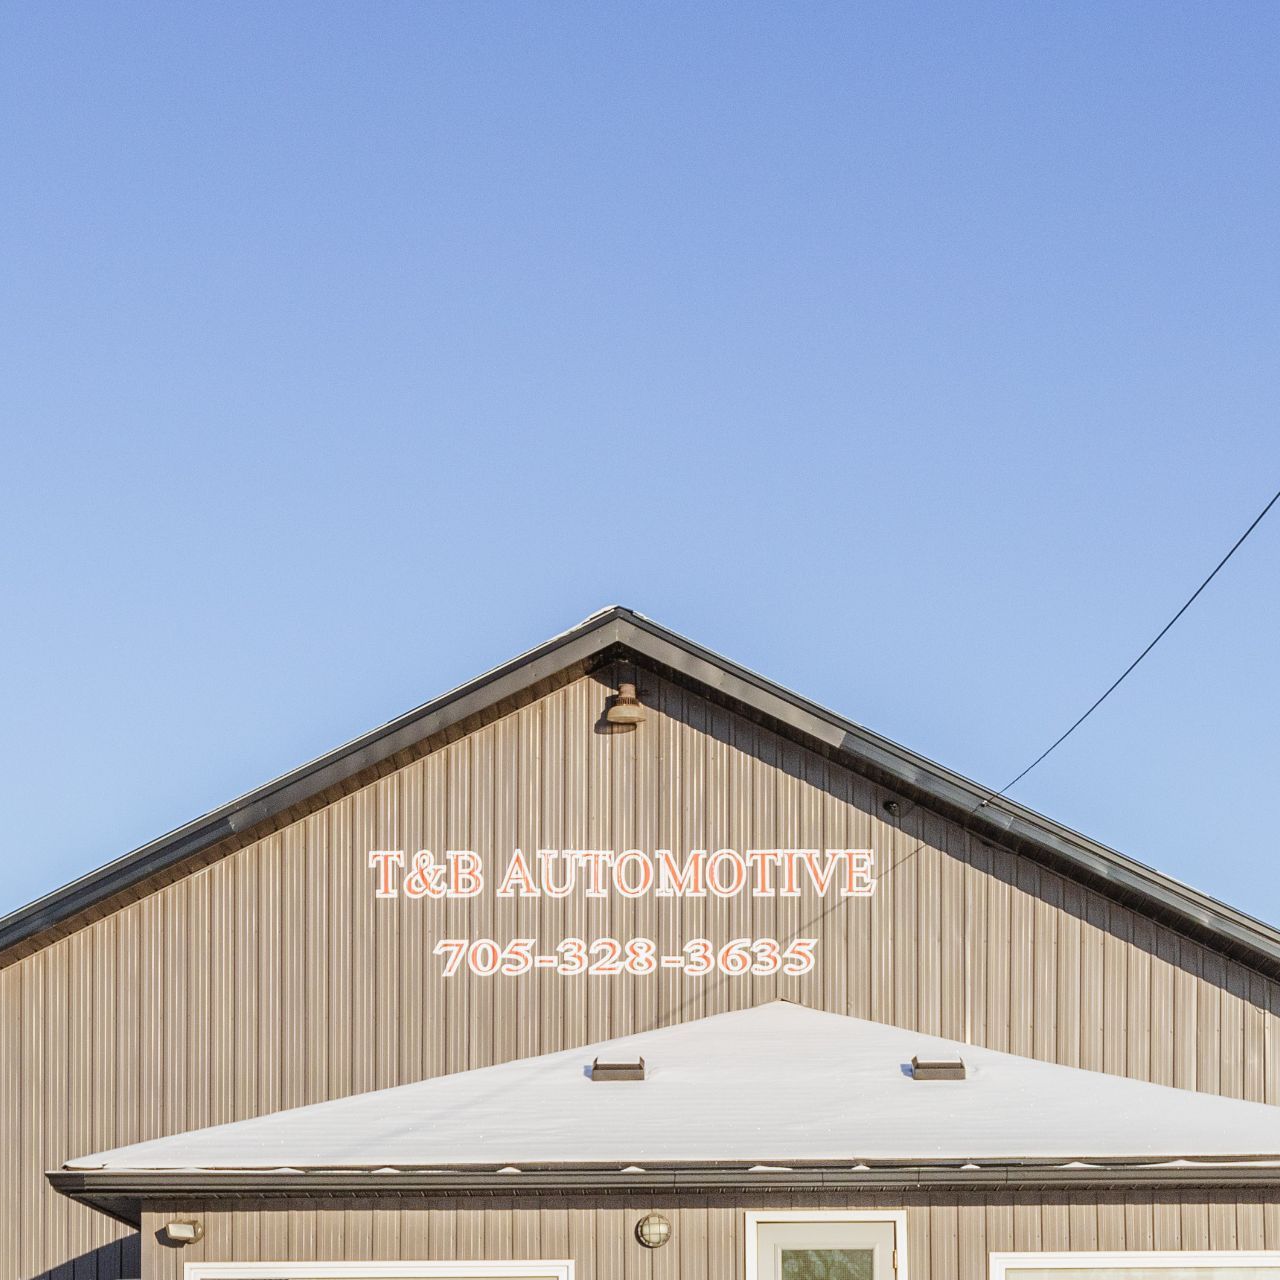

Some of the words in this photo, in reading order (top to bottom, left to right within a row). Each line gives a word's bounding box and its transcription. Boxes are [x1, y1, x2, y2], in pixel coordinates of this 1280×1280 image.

[369, 850, 484, 898] T&B
[496, 848, 878, 898] AUTOMOTIVE
[432, 937, 818, 977] 705-328-3635
